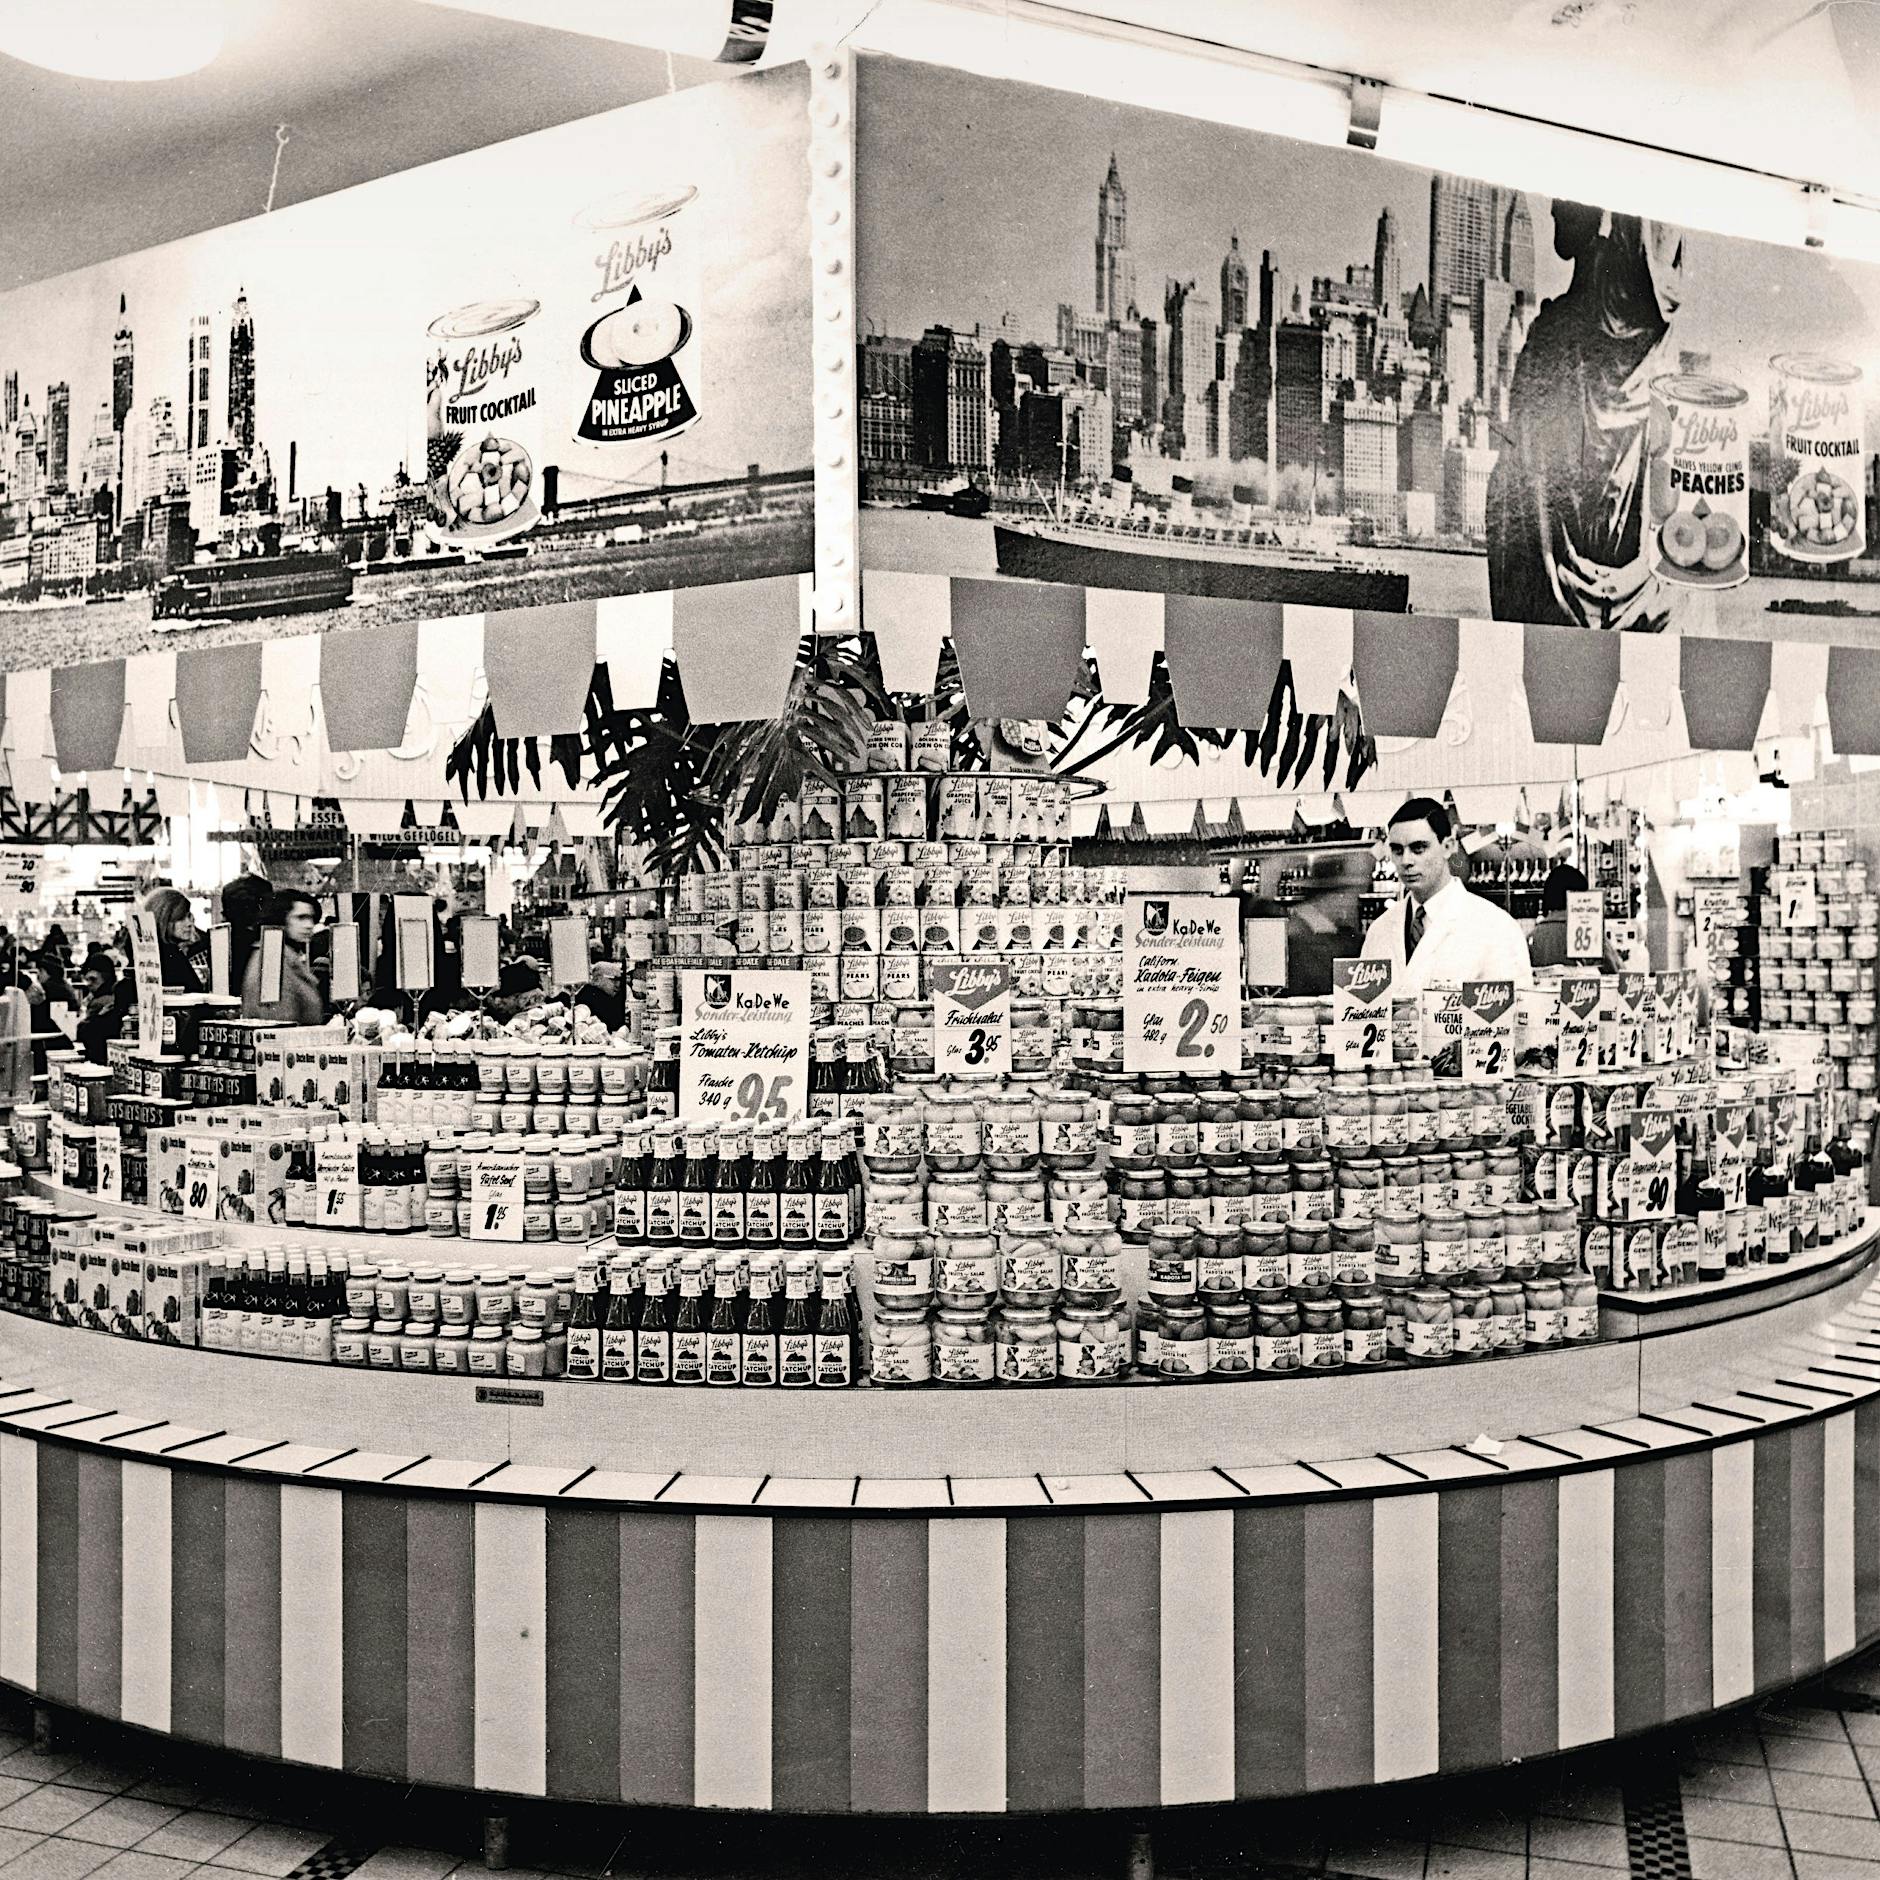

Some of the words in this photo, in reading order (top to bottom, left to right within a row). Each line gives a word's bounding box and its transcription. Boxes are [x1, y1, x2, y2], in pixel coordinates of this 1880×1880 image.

[591, 227, 672, 302] Libby's
[449, 337, 522, 403] Libby's
[614, 373, 657, 395] SLICED
[446, 401, 477, 424] FRUIT
[480, 387, 536, 420] COCKTAIL
[592, 383, 681, 425] PINEAPPLE
[1789, 390, 1848, 431] Libby's
[609, 426, 627, 436] EXTRA
[628, 424, 647, 434] HEAVY
[648, 419, 668, 431] SYRUP
[1673, 412, 1738, 454] Libby's
[1786, 433, 1811, 454] FRUIT
[1815, 439, 1859, 457] COCKTAIL
[1673, 457, 1696, 471] HALVES
[1700, 462, 1722, 472] YELLOW
[1726, 461, 1742, 471] CLING
[1671, 468, 1744, 494] PEACHES
[873, 723, 893, 736] Libby's
[404, 830, 454, 842] GEFLÜGEL
[1173, 919, 1221, 935] KaDeWe
[1575, 926, 1592, 951] 85
[945, 967, 1001, 997] Libby's
[1345, 962, 1388, 991] Libby's
[736, 993, 790, 1008] KaDeWe
[1471, 985, 1510, 1011] Libby's
[1567, 981, 1598, 1008] Libby's
[1144, 1013, 1163, 1029] Glas
[690, 1028, 727, 1044] Libby's
[1143, 1030, 1158, 1041] 482
[698, 1073, 734, 1087] Flasche
[699, 1092, 721, 1106] 340
[1638, 1113, 1672, 1143] Libby's
[189, 1181, 207, 1208] 80
